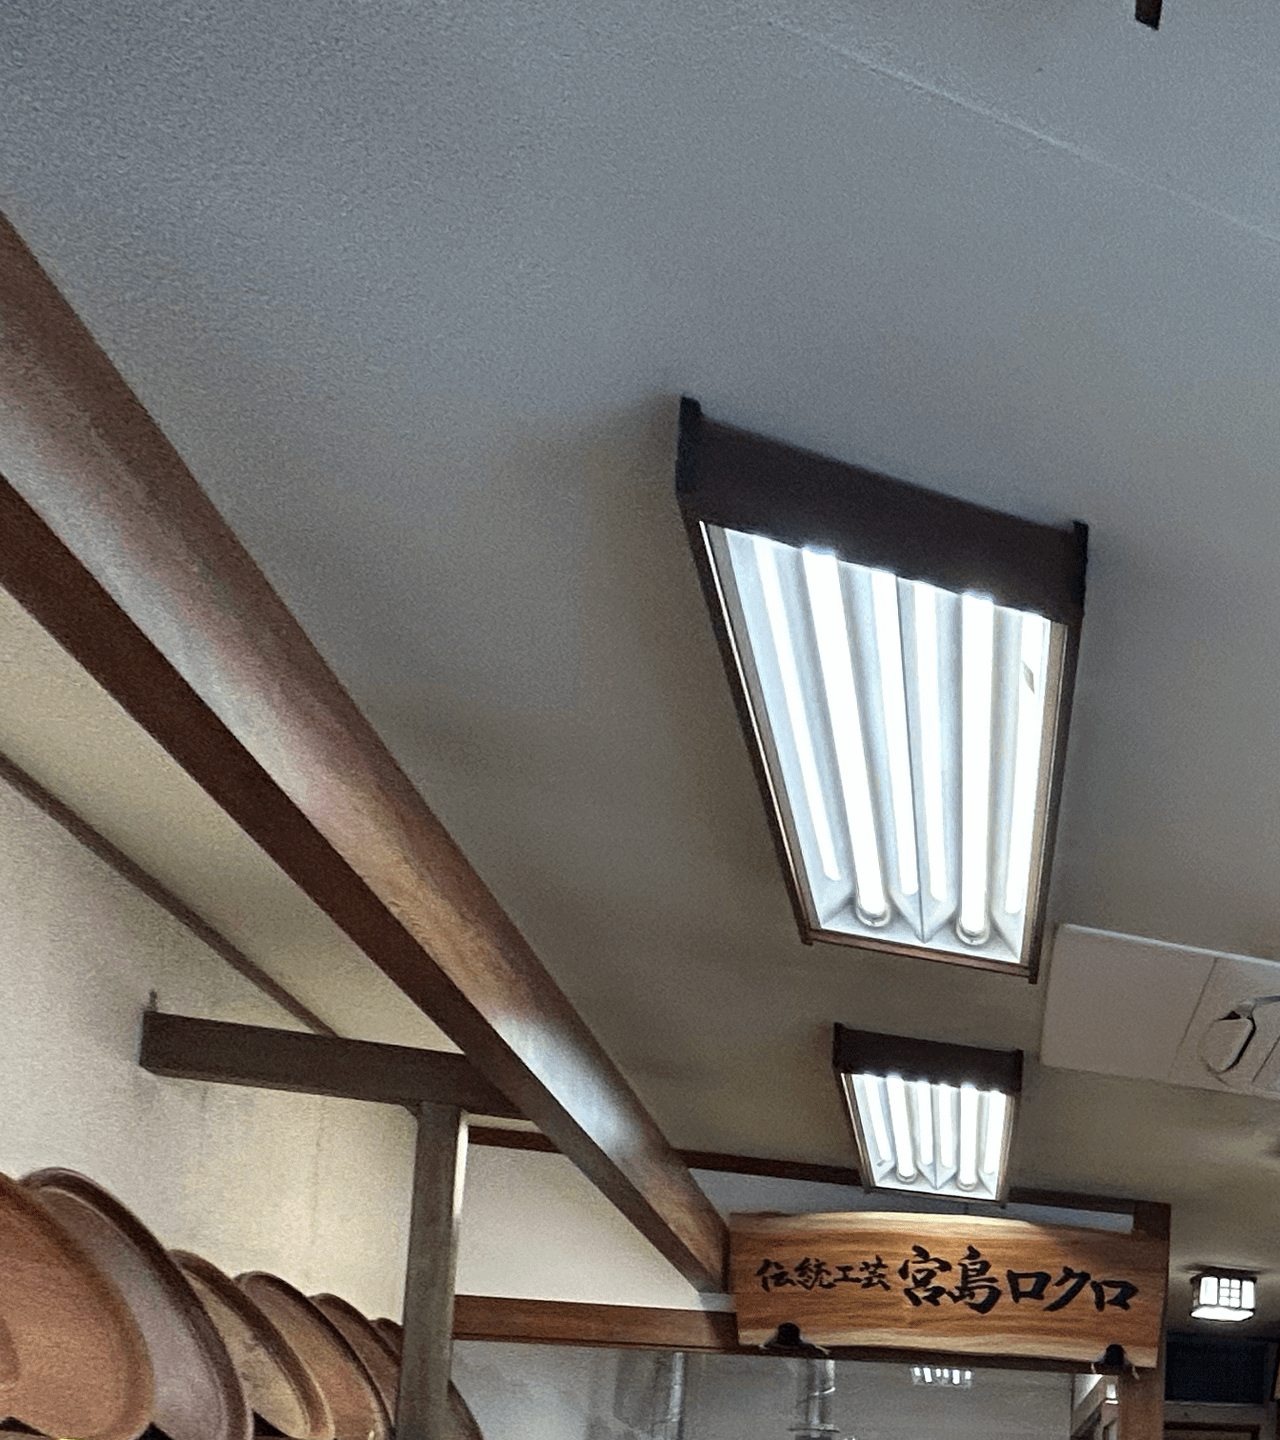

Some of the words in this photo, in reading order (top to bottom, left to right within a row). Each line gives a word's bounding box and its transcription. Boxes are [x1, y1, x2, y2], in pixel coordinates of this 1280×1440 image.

[756, 1255, 892, 1292] 伝統工芸
[899, 1245, 1139, 1314] 宮島ロクロ
